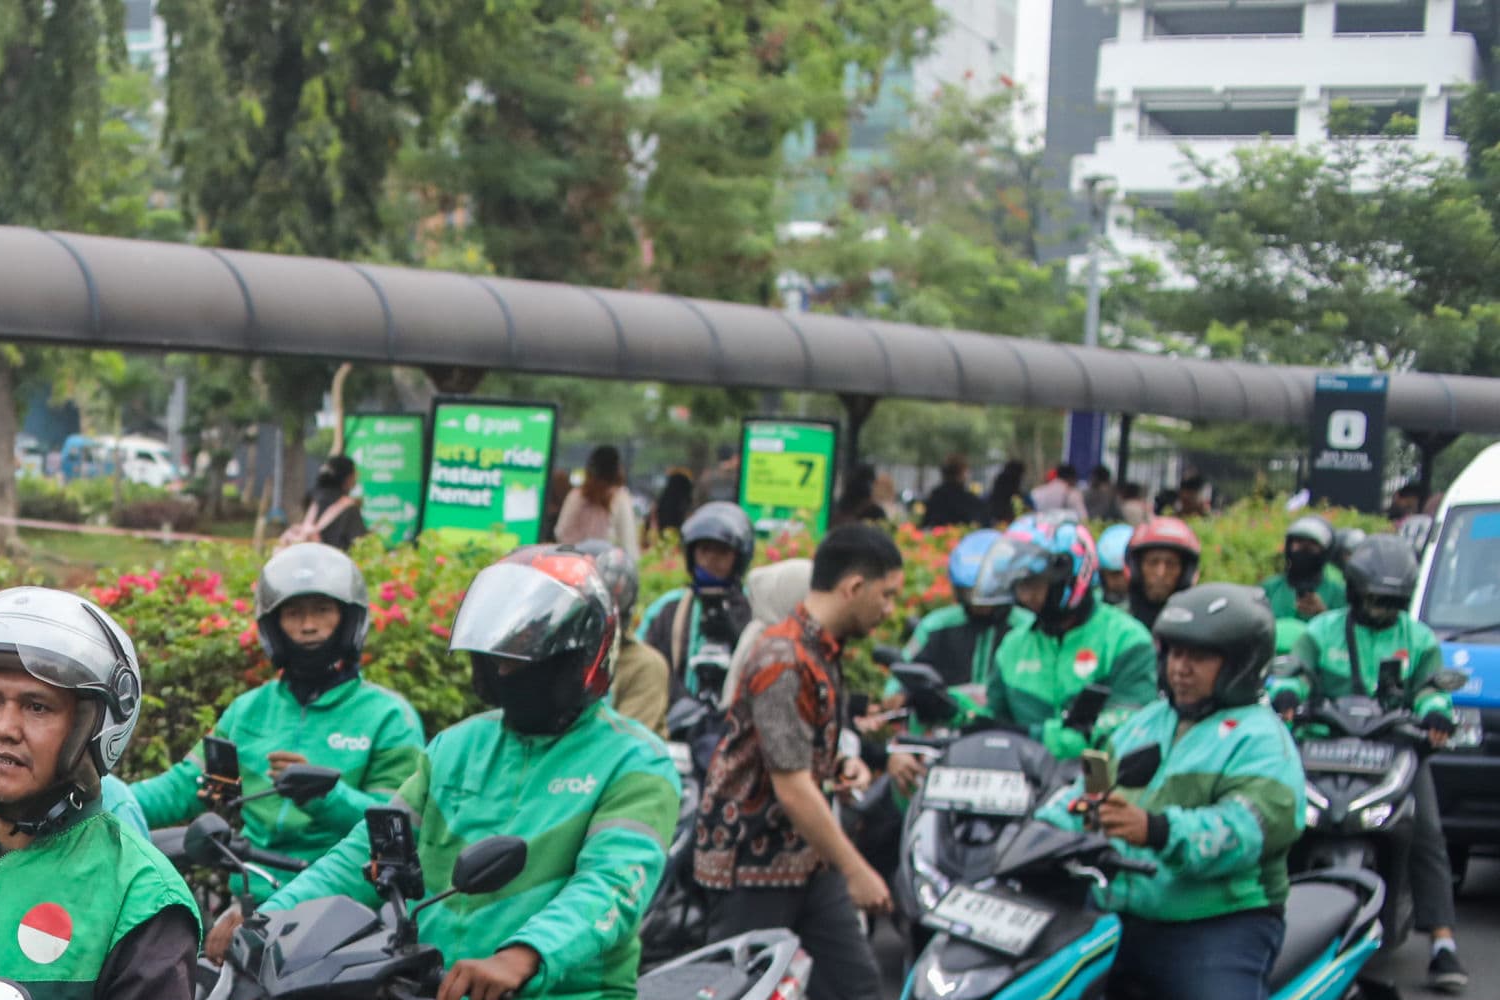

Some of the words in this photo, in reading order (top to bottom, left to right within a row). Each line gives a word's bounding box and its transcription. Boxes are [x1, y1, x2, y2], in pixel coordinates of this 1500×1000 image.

[432, 462, 502, 486] instant
[796, 459, 815, 486] 7
[429, 483, 492, 507] hemat
[327, 732, 372, 751] Grab
